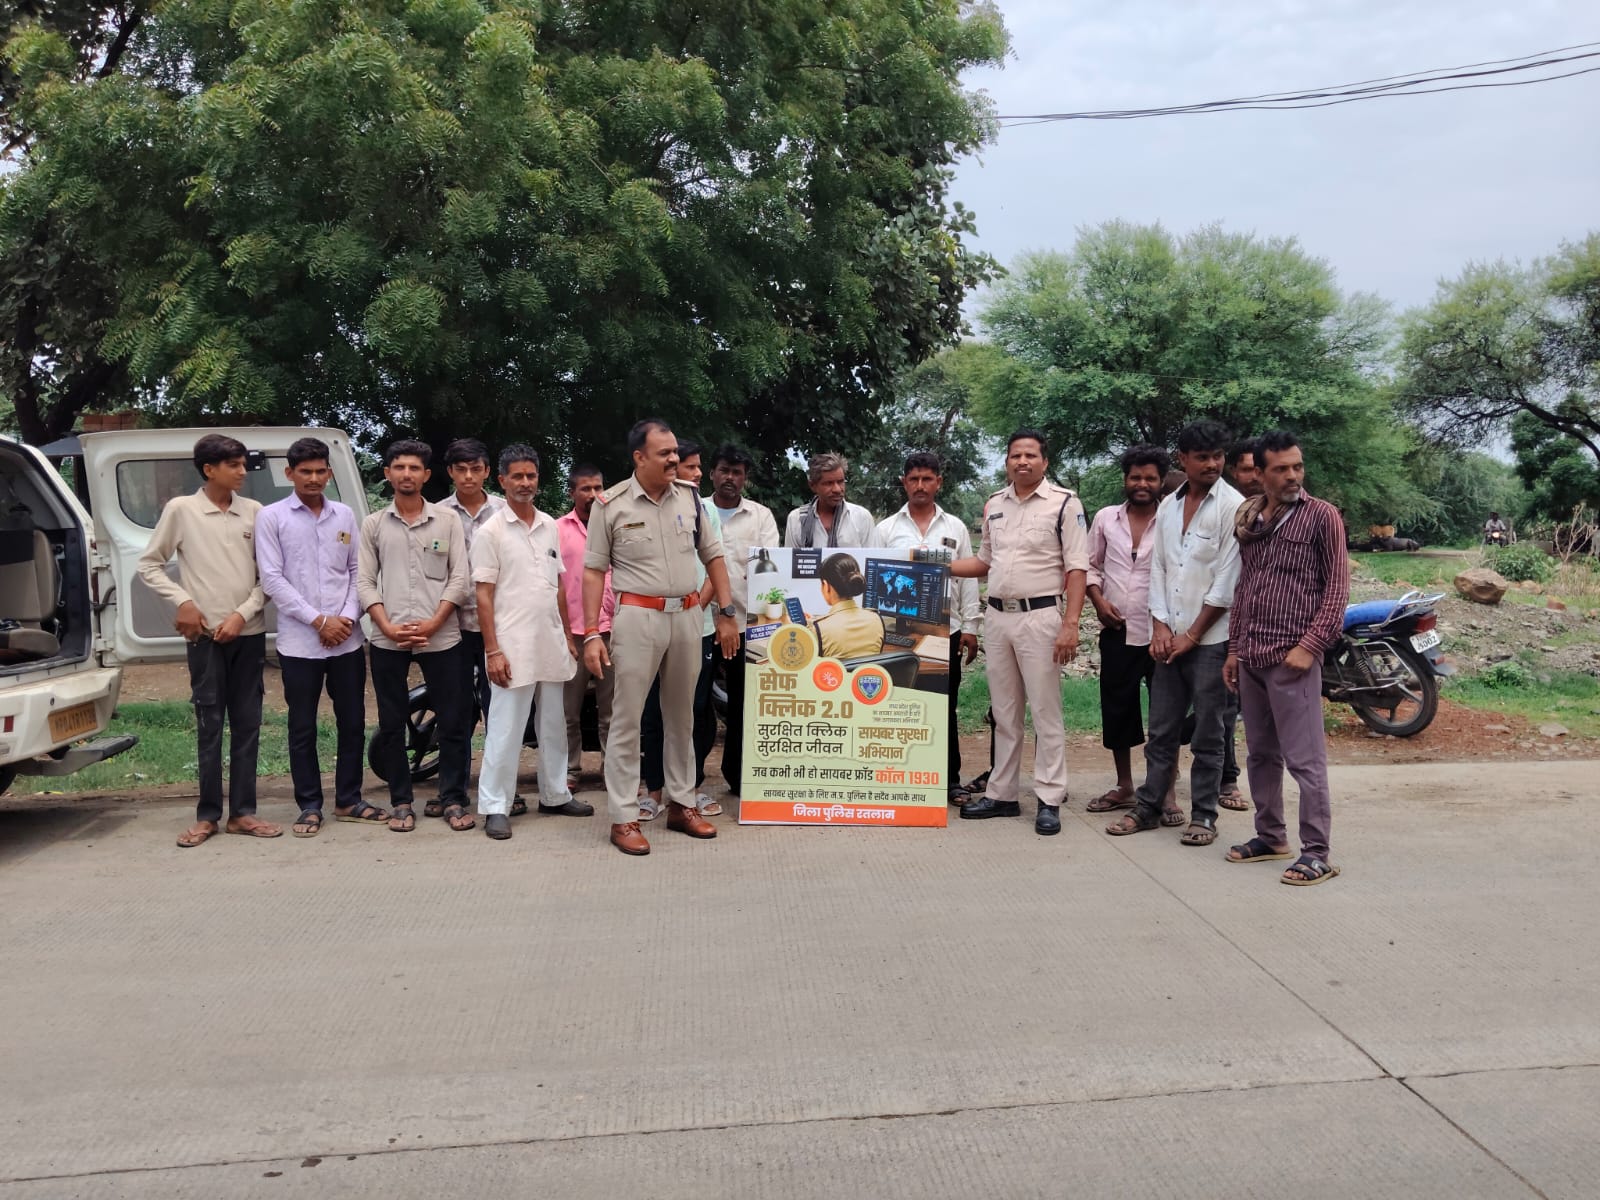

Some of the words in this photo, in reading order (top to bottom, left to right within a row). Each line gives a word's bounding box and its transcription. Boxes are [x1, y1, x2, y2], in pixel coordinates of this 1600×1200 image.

[759, 668, 798, 691] सेफ
[758, 693, 816, 717] क्लिक
[821, 700, 853, 718] 2.0
[758, 721, 803, 739] सुरक्षित
[806, 722, 848, 737] क्लिक
[858, 727, 895, 739] सायबर
[896, 728, 928, 744] सुरक्षा
[757, 738, 802, 756] सुरक्षित
[806, 739, 843, 754] जीवन
[858, 743, 904, 759] अभियान
[752, 766, 767, 777] जब
[769, 765, 790, 778] कभी
[793, 765, 805, 778] भी
[808, 765, 818, 779] हो
[820, 769, 852, 780] सायबर
[855, 766, 873, 781] फ्रॉड
[875, 766, 905, 784] कॉल
[908, 771, 939, 785] 1930
[763, 789, 786, 798] सायबर
[787, 789, 806, 800] सुरक्षा
[807, 789, 814, 798] के
[815, 788, 829, 799] लिए
[847, 790, 866, 802] पुलिस
[868, 791, 872, 800] है
[874, 791, 888, 801] सदैव
[890, 792, 910, 801] आपके
[911, 794, 926, 803] साथ
[793, 803, 821, 817] जिला
[823, 804, 854, 821] पुलिस
[856, 808, 895, 820] रतलाम
